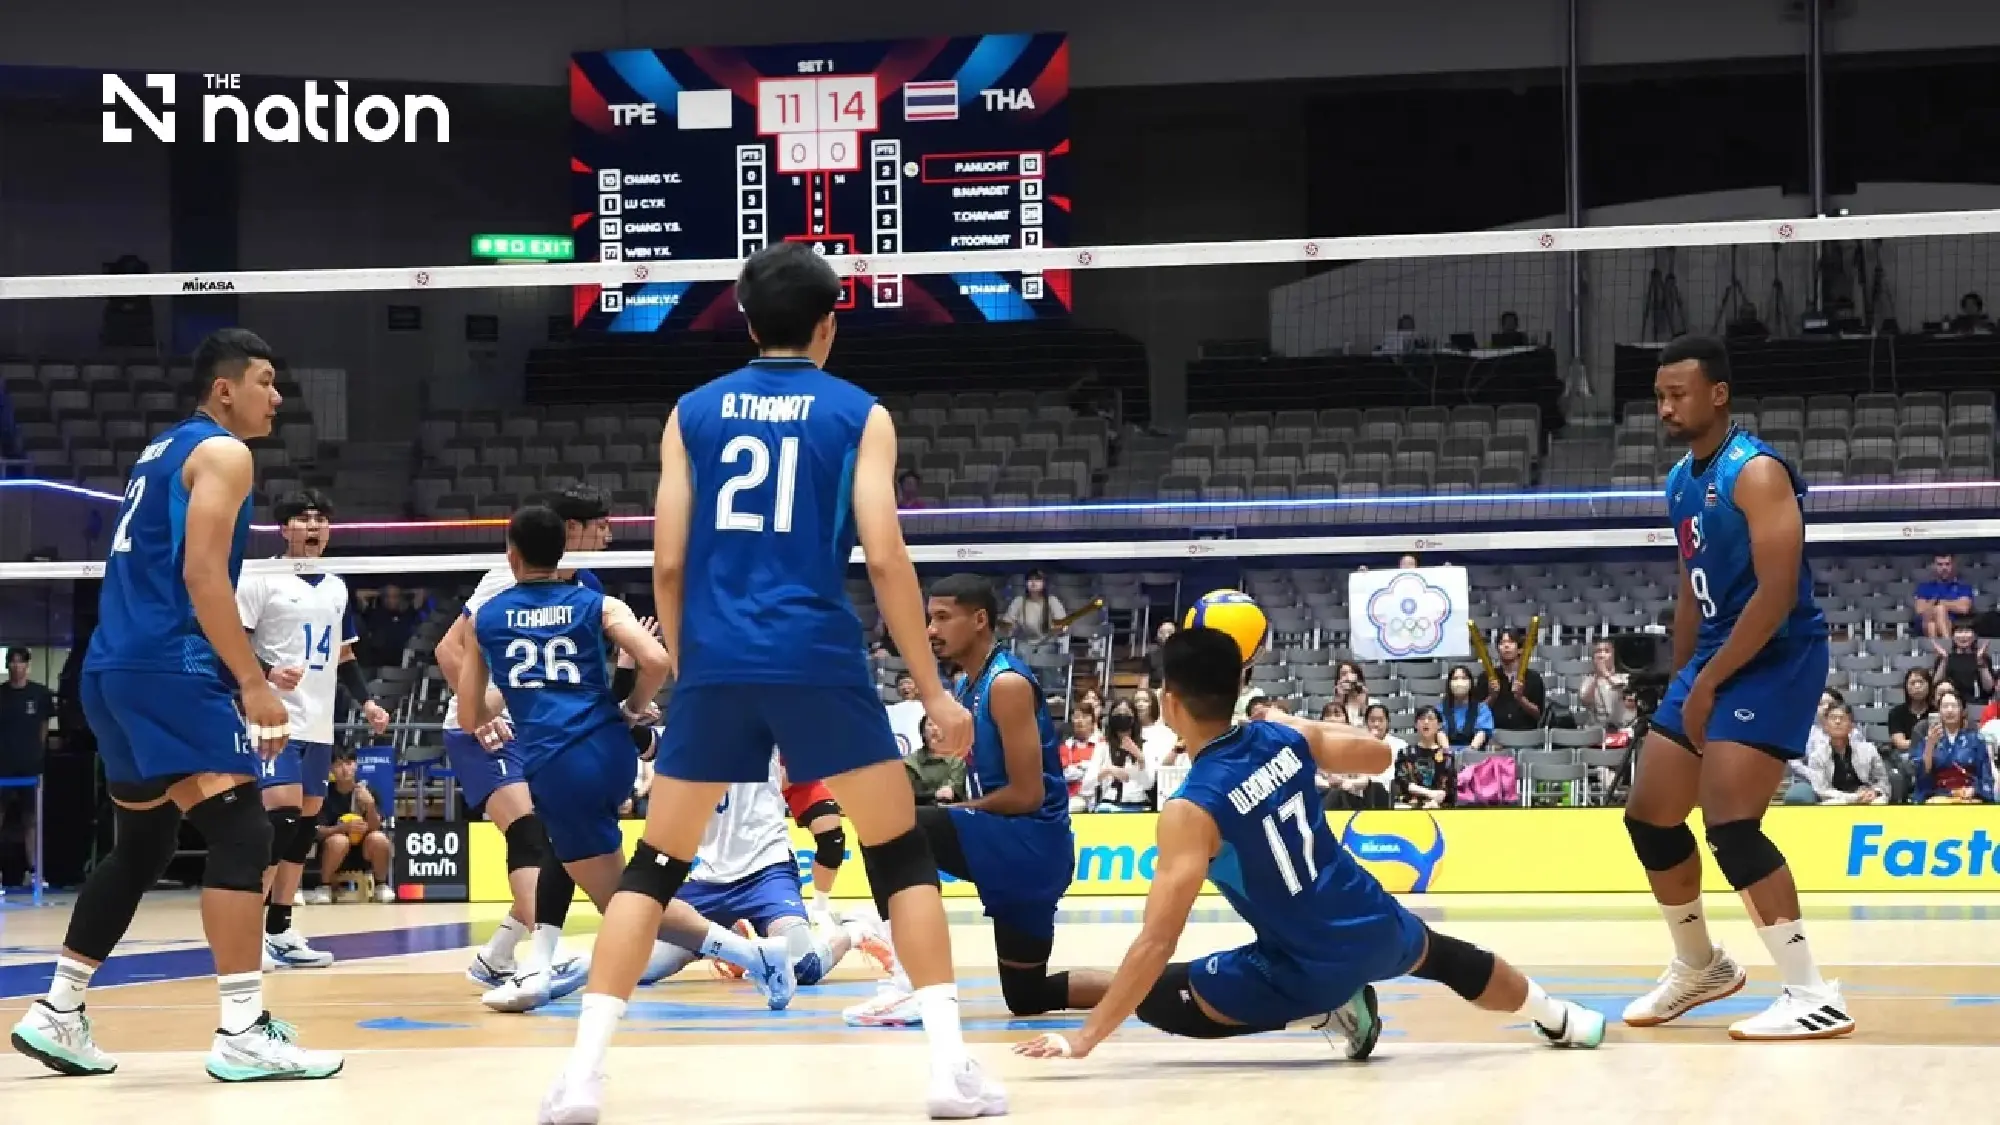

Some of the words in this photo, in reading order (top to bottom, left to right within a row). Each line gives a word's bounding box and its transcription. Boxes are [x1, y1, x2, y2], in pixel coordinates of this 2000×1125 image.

[797, 61, 823, 73] SET
[828, 60, 834, 72] 1
[775, 93, 801, 124] 11
[828, 90, 866, 123] 14
[980, 88, 1035, 111] THA
[608, 103, 657, 126] TPE
[791, 142, 806, 164] 0
[830, 141, 846, 162] 0
[747, 170, 757, 182] 0
[531, 239, 573, 255] EXIT
[721, 391, 816, 423] B.THANAT
[715, 434, 799, 533] 21
[1691, 567, 1717, 618] 9
[505, 605, 573, 629] T.CHAIWAT
[303, 622, 332, 663] 14
[505, 635, 581, 689] 26
[406, 832, 459, 856] 68.0
[1262, 791, 1319, 897] 17
[1846, 824, 2000, 877] Fast
[408, 857, 457, 877] km/h
